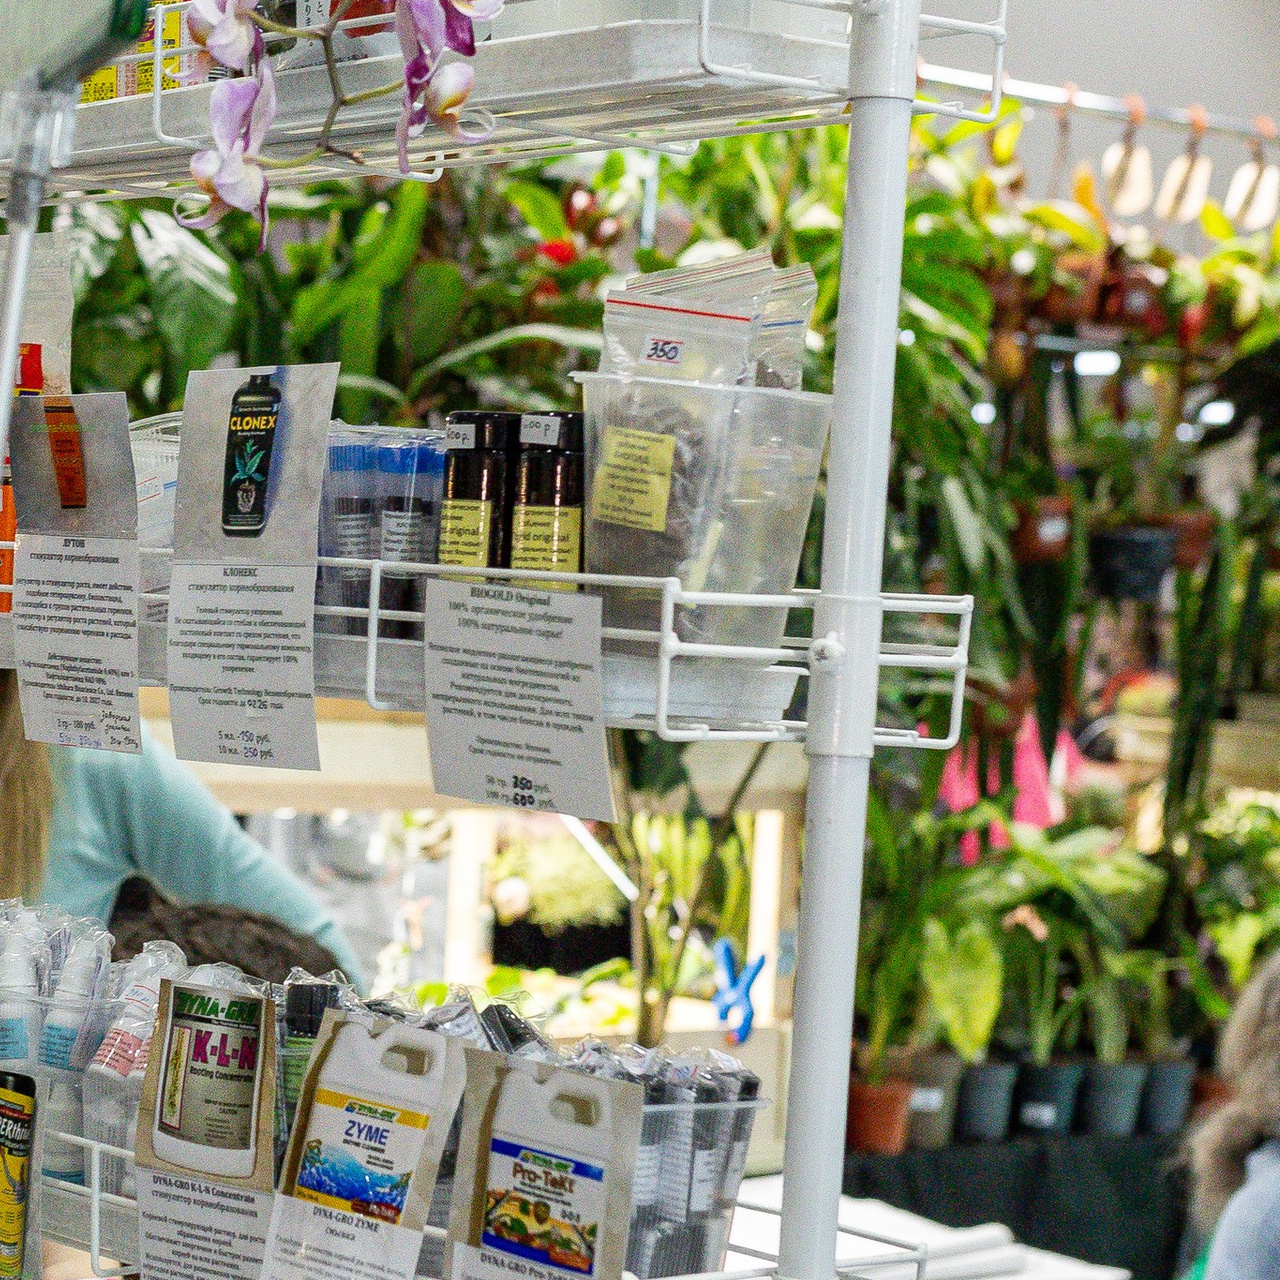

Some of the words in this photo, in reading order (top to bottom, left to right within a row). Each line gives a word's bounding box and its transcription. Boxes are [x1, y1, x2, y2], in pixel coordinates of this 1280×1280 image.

[645, 340, 680, 361] 350
[191, 1029, 258, 1070] K-L-N
[343, 1119, 391, 1146] ZYME
[152, 1175, 190, 1191] DYNA-GRO
[211, 1187, 255, 1204] Concentrate
